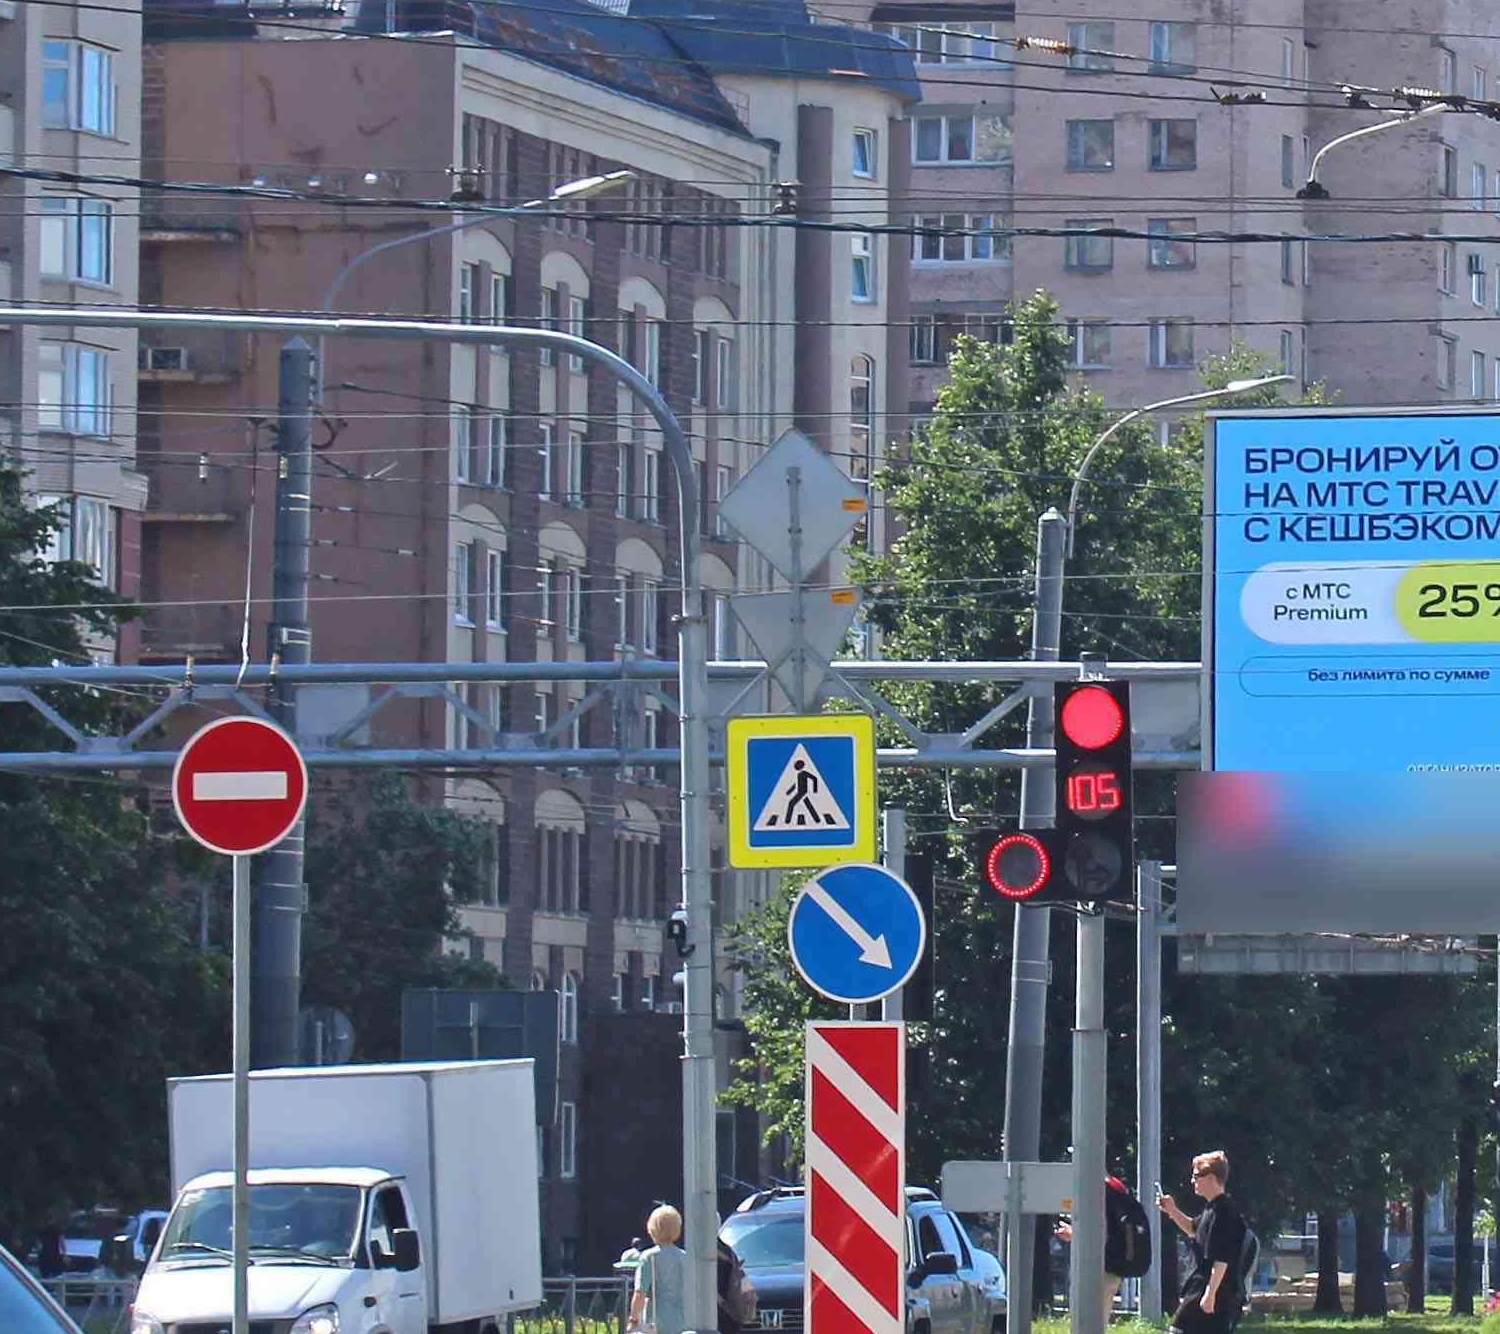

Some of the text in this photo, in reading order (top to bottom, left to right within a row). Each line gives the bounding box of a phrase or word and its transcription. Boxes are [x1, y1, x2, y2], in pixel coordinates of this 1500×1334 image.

[1244, 438, 1461, 474] БРОНИРУЙ
[1244, 482, 1299, 508] НА
[1306, 481, 1390, 508] МТС
[1244, 516, 1271, 543] С
[1285, 582, 1351, 600] с МТС
[1273, 603, 1368, 622] Premium
[1307, 667, 1491, 684] без лимита по сумме
[1068, 772, 1120, 811] 105
